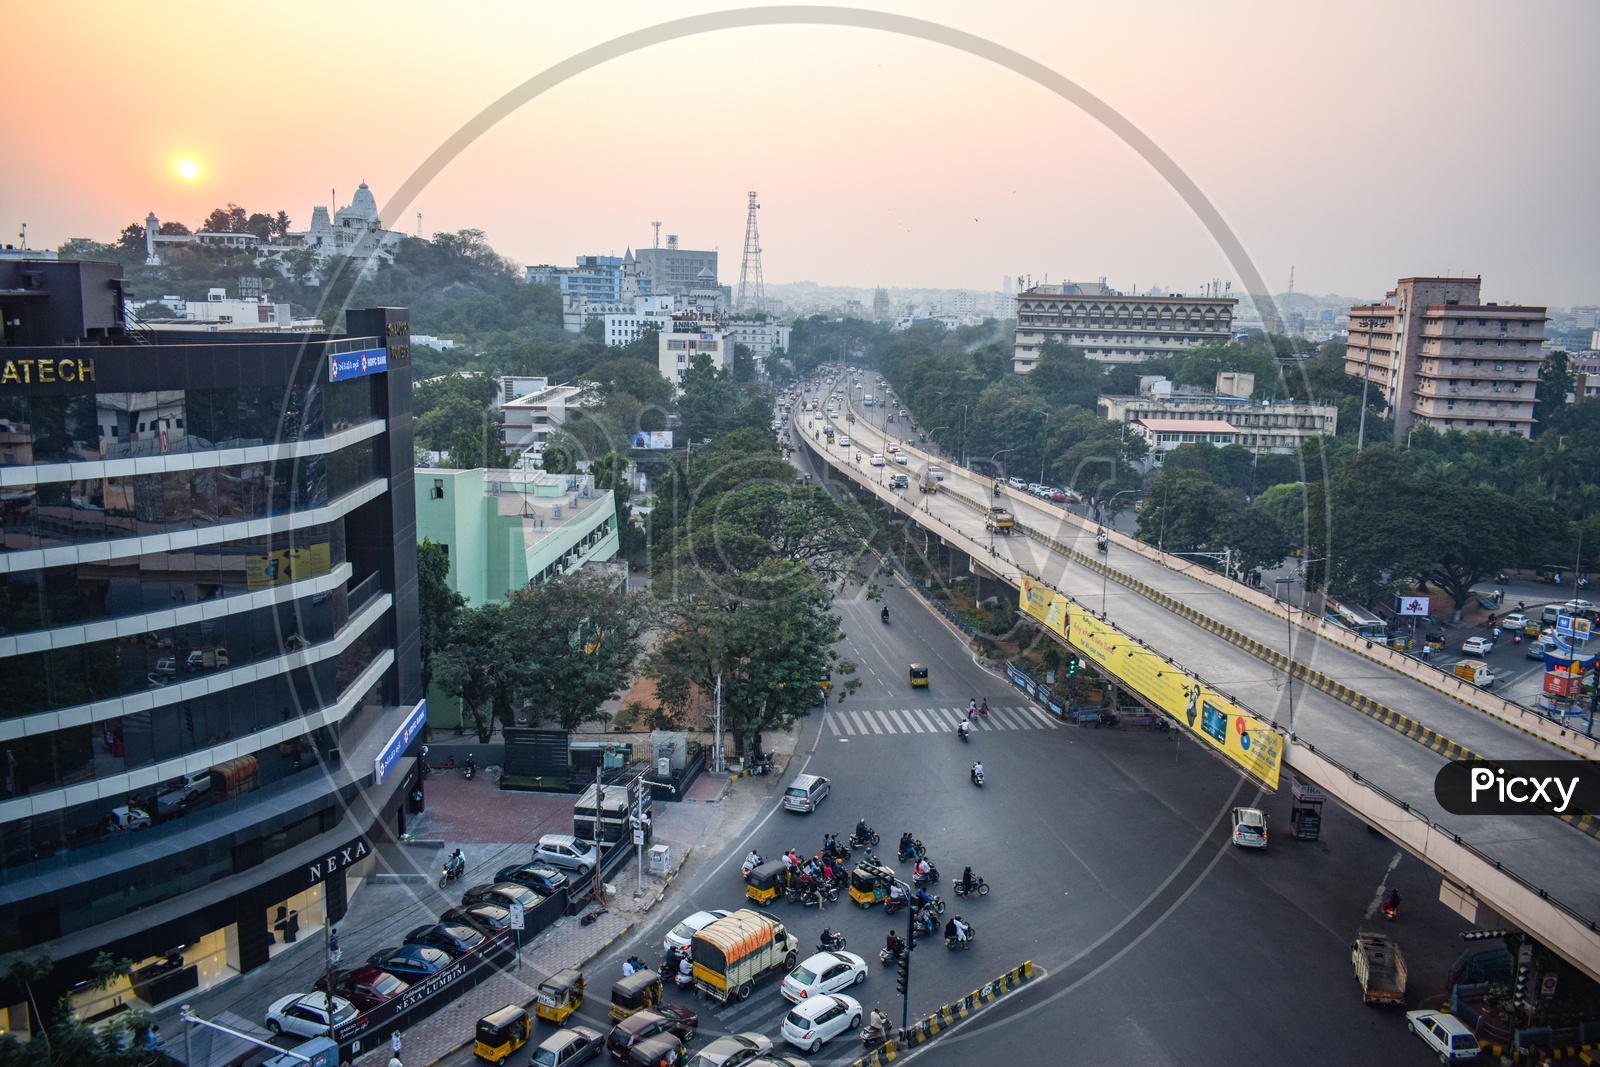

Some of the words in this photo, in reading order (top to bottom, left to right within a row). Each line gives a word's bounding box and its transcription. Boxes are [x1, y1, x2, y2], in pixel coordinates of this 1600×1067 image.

[0, 358, 96, 384] ATECH
[367, 357, 377, 367] HDFC
[377, 355, 387, 366] BANK
[309, 842, 366, 882] NEXA
[396, 993, 423, 1013] NEXA
[426, 965, 467, 995] LUMBINI
